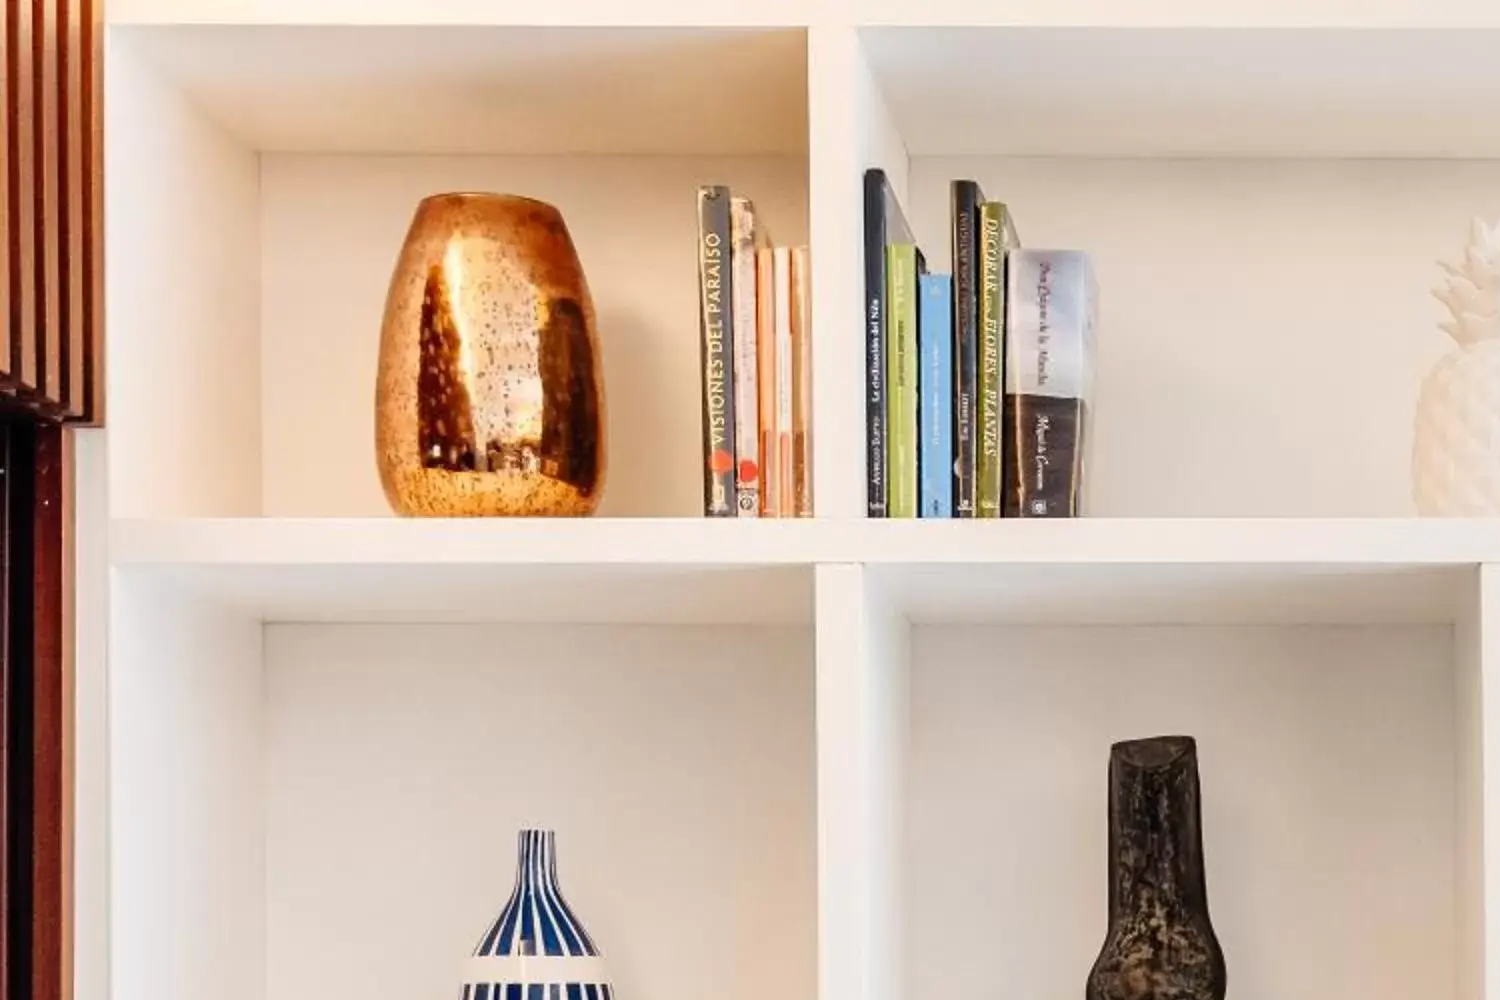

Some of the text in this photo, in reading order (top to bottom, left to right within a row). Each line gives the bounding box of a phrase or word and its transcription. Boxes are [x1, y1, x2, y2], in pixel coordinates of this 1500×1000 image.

[984, 217, 1000, 292] DECORAR
[705, 232, 725, 444] VISIONES DEL PARAÍSO
[985, 317, 998, 375] FLORES
[985, 389, 998, 457] PLANTAS
